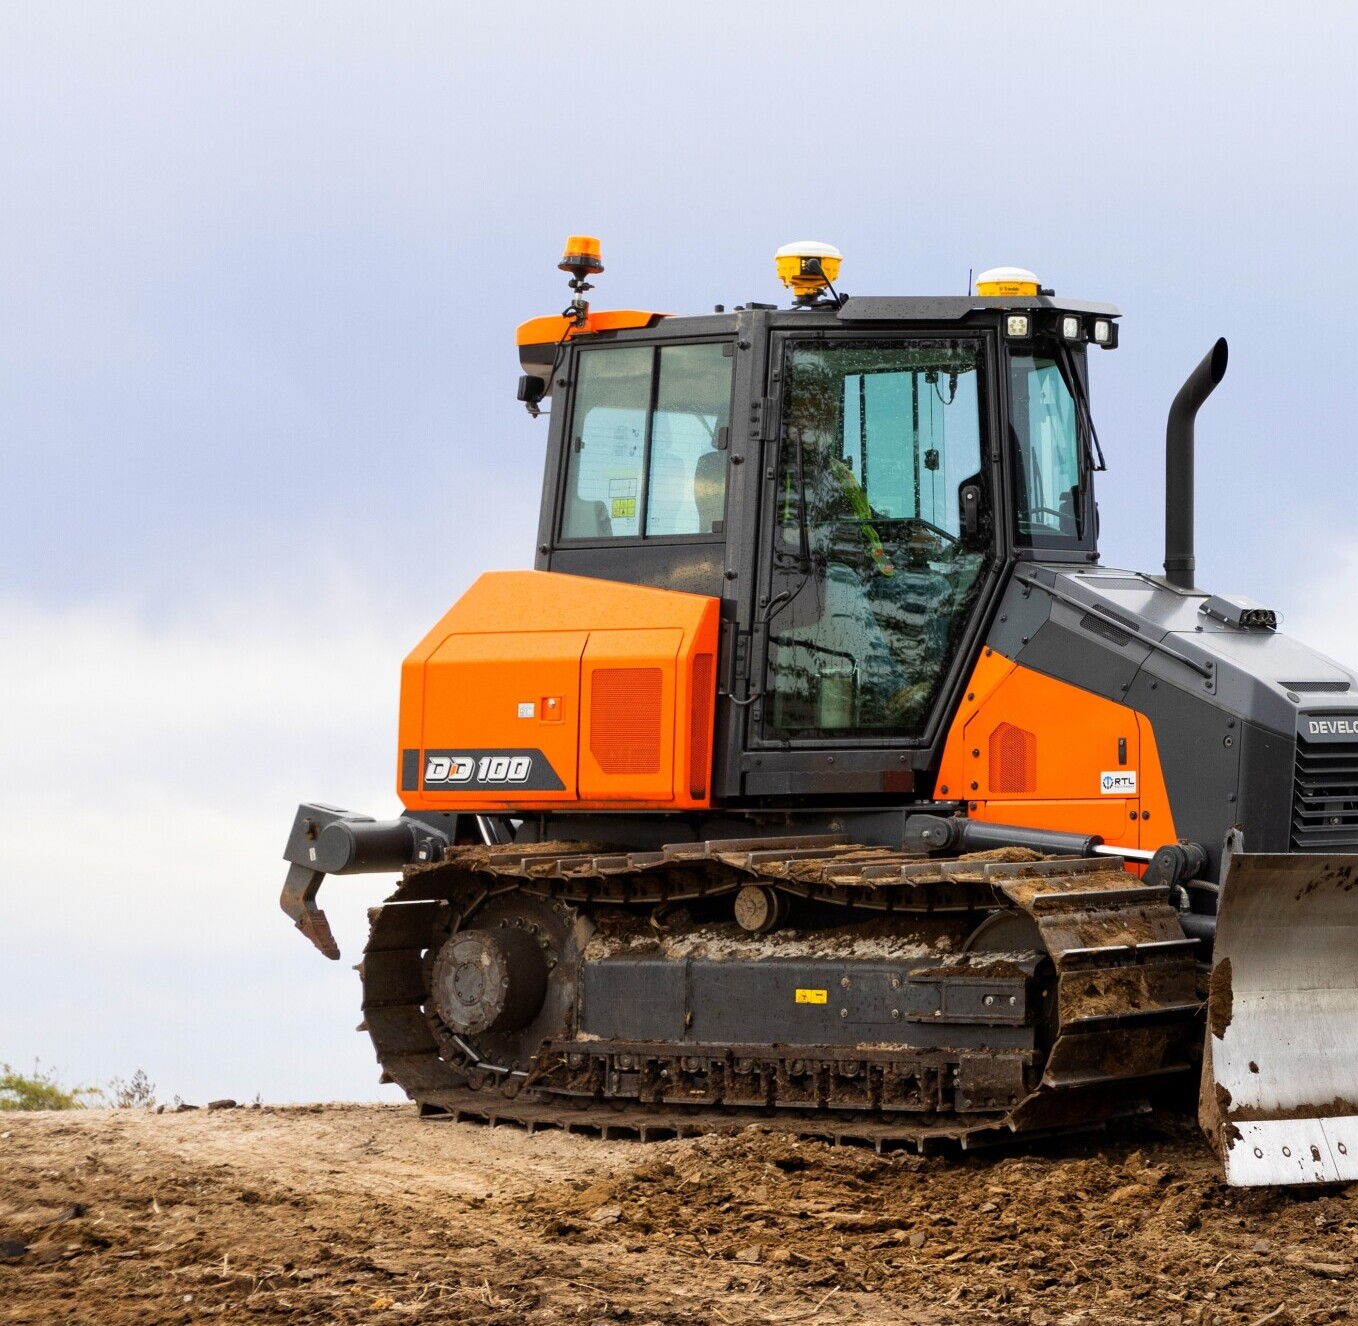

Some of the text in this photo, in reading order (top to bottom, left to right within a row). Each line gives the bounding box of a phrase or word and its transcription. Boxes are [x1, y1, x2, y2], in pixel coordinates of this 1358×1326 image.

[425, 757, 532, 783] DD 100
[1114, 777, 1135, 785] RTL
